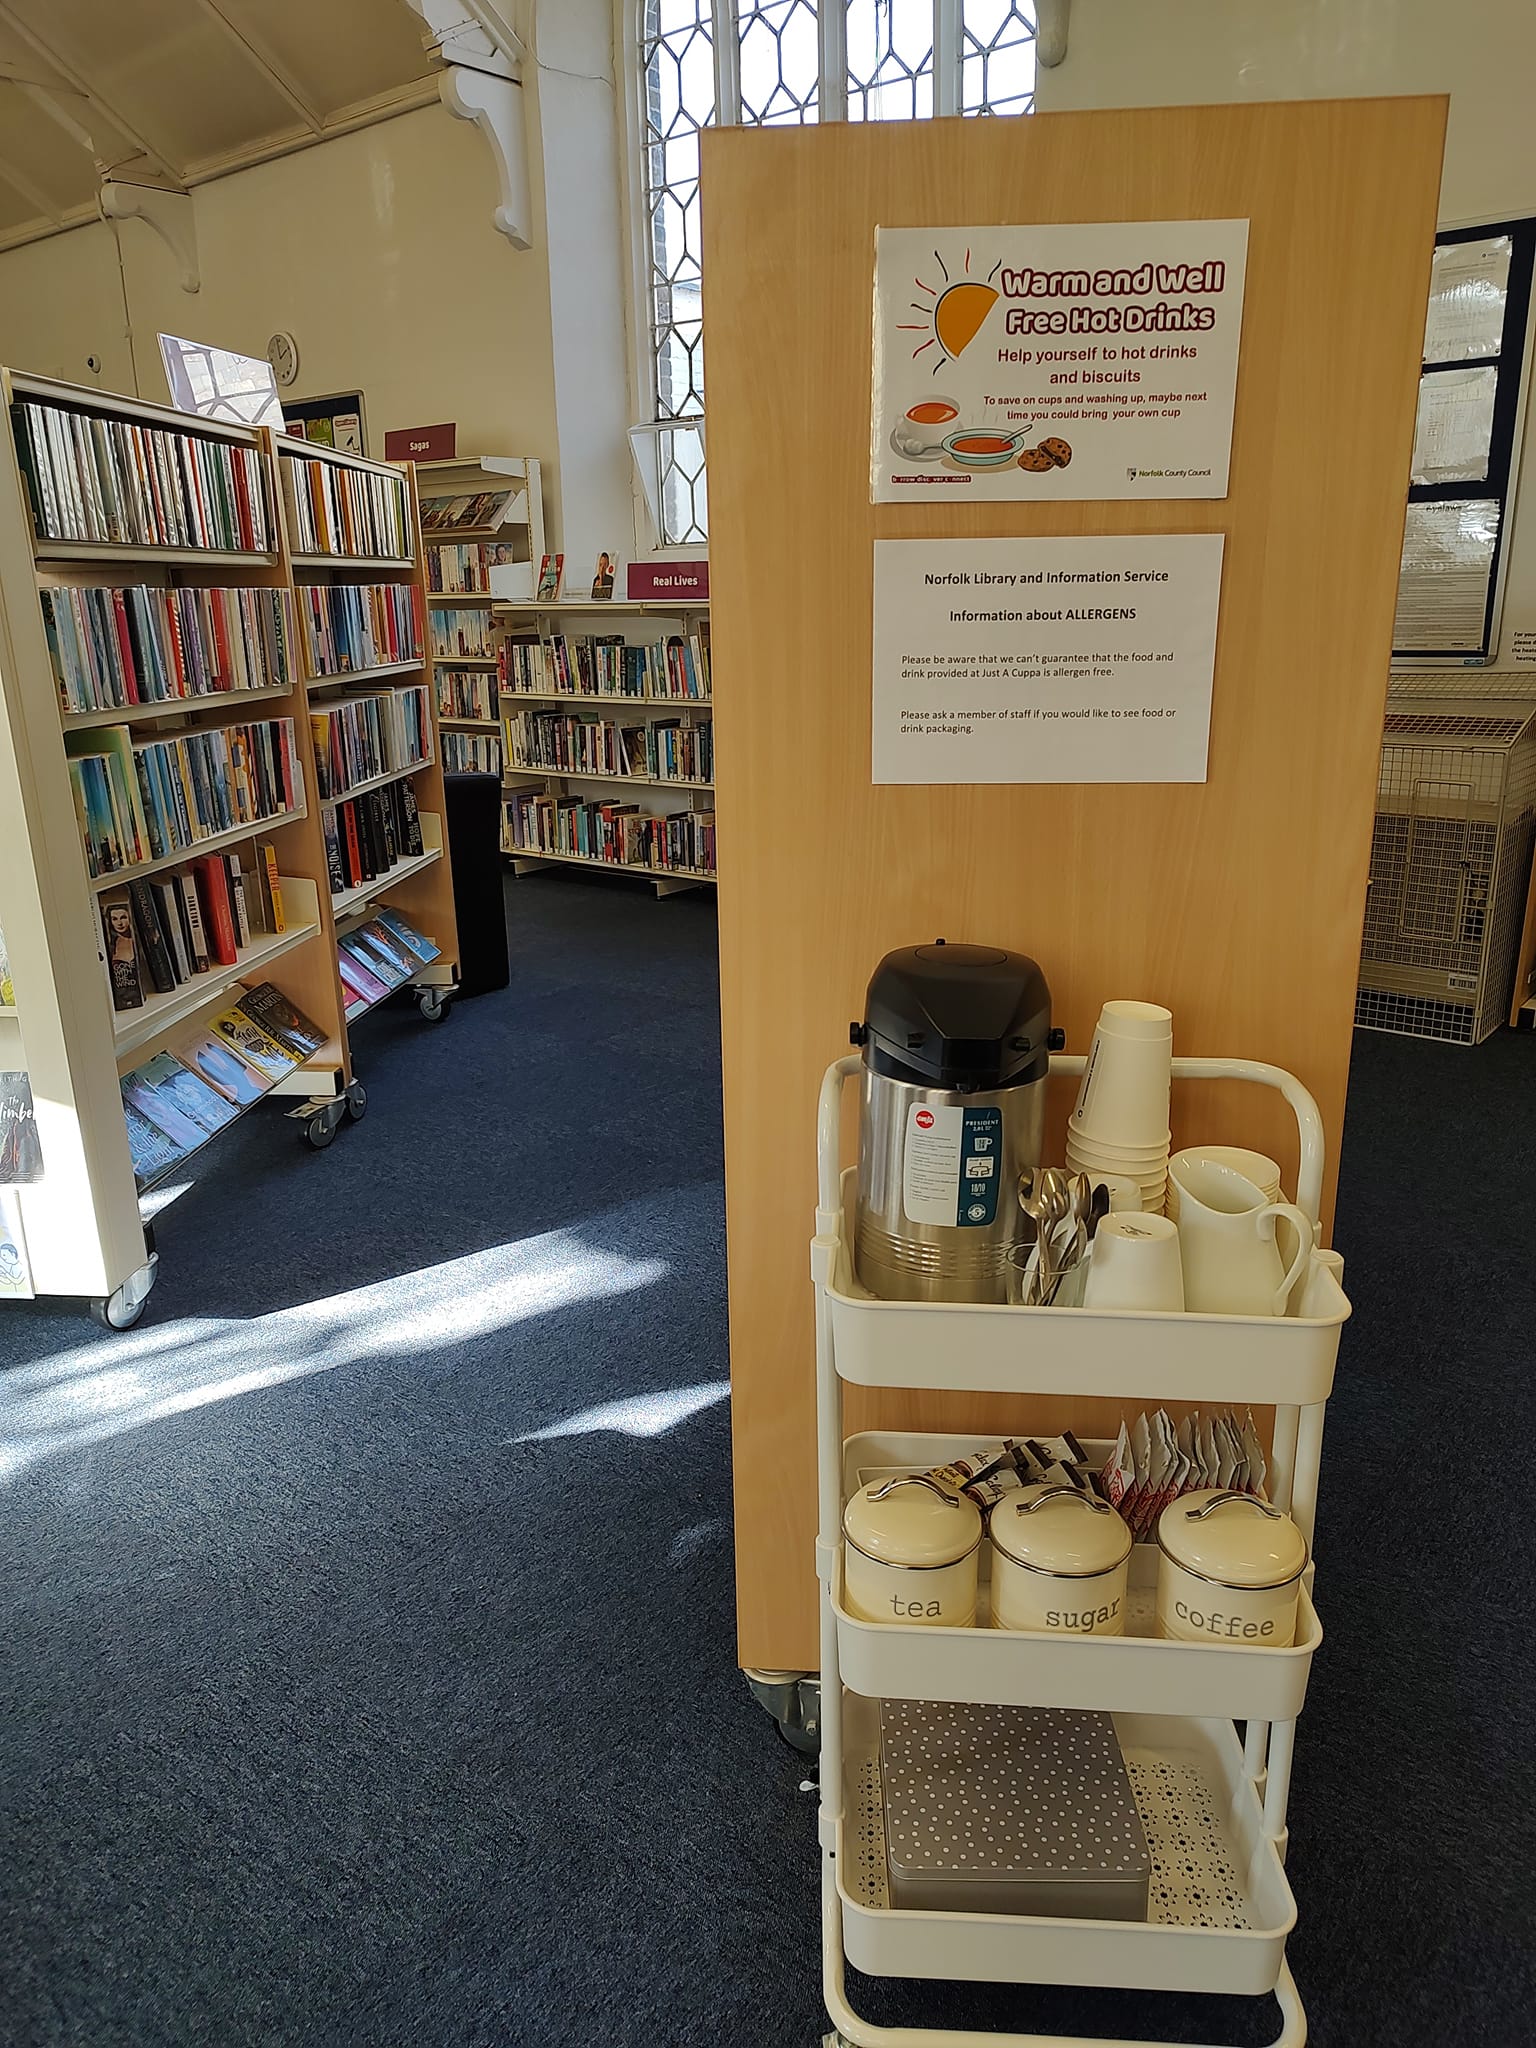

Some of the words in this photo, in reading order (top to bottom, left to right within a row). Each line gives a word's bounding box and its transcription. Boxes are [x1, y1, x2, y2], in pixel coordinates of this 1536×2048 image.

[1001, 268, 1089, 298] Warm
[1091, 263, 1154, 296] and
[1154, 260, 1226, 295] Well
[1005, 307, 1068, 335] Free
[1069, 305, 1122, 334] Hot
[1123, 302, 1216, 333] Drinks
[998, 348, 1032, 365] Help
[1035, 346, 1097, 364] yourself
[1102, 346, 1116, 360] to
[1121, 345, 1145, 359] hot
[1149, 344, 1196, 358] drinks
[1050, 370, 1077, 384] and
[1082, 368, 1140, 383] biscuits
[983, 395, 995, 405] To
[1022, 396, 1035, 404] on
[1037, 396, 1062, 406] cups
[1064, 394, 1083, 403] and
[1086, 393, 1128, 405] washing
[1130, 395, 1145, 404] up,
[1148, 391, 1182, 404] maybe
[1185, 391, 1207, 401] next
[1007, 410, 1028, 419] time
[1030, 412, 1048, 421] you
[1051, 409, 1079, 419] could
[1081, 408, 1107, 420] bring
[1112, 410, 1135, 420] your
[1137, 409, 1158, 417] own
[1161, 409, 1180, 418] cup
[409, 441, 430, 452] Sagas
[1138, 469, 1163, 477] Norfolk
[1164, 469, 1186, 478] County
[1187, 468, 1211, 476] Council
[653, 575, 672, 586] Real
[674, 574, 698, 586] Lives
[924, 572, 970, 584] Norfolk
[974, 572, 1016, 586] Library
[1019, 571, 1042, 583] and
[1046, 570, 1120, 583] Information
[1124, 569, 1168, 582] Service
[950, 609, 1022, 621] Information
[1026, 608, 1062, 620] about
[1065, 608, 1136, 620] ALLERGENS
[902, 655, 930, 664] Please
[933, 655, 945, 664] be
[947, 656, 976, 664] aware
[978, 654, 997, 663] that
[1016, 653, 1039, 663] can't
[1041, 654, 1089, 664] guarantee
[1092, 652, 1110, 662] that
[1113, 652, 1128, 661] the
[1131, 651, 1153, 661] food
[1155, 652, 1173, 661] and
[901, 669, 924, 678] drink
[927, 668, 968, 679] provided
[970, 669, 979, 677] at
[982, 668, 999, 677] Just
[1002, 668, 1009, 677] A
[1011, 668, 1040, 679] Cuppa
[1043, 668, 1050, 677] is
[1053, 667, 1090, 678] allergen
[1093, 666, 1114, 676] free.
[901, 710, 929, 719] Please
[932, 710, 947, 719] ask
[957, 709, 996, 719] member
[998, 709, 1008, 718] of
[1010, 709, 1031, 718] staff
[1033, 709, 1040, 718] if
[1041, 711, 1058, 720] you
[1061, 708, 1090, 718] would
[1092, 708, 1108, 717] like
[1111, 709, 1121, 717] to
[1142, 707, 1163, 717] food
[900, 723, 923, 733] drink
[926, 723, 973, 734] packaging.
[402, 784, 414, 822] PATTERSON
[266, 863, 280, 891] KEEPER
[113, 961, 136, 970] GONE
[965, 1119, 999, 1127] PRESIDENT
[891, 1594, 941, 1617] tea
[1046, 1596, 1120, 1632] sugar
[1174, 1600, 1274, 1638] coffee
